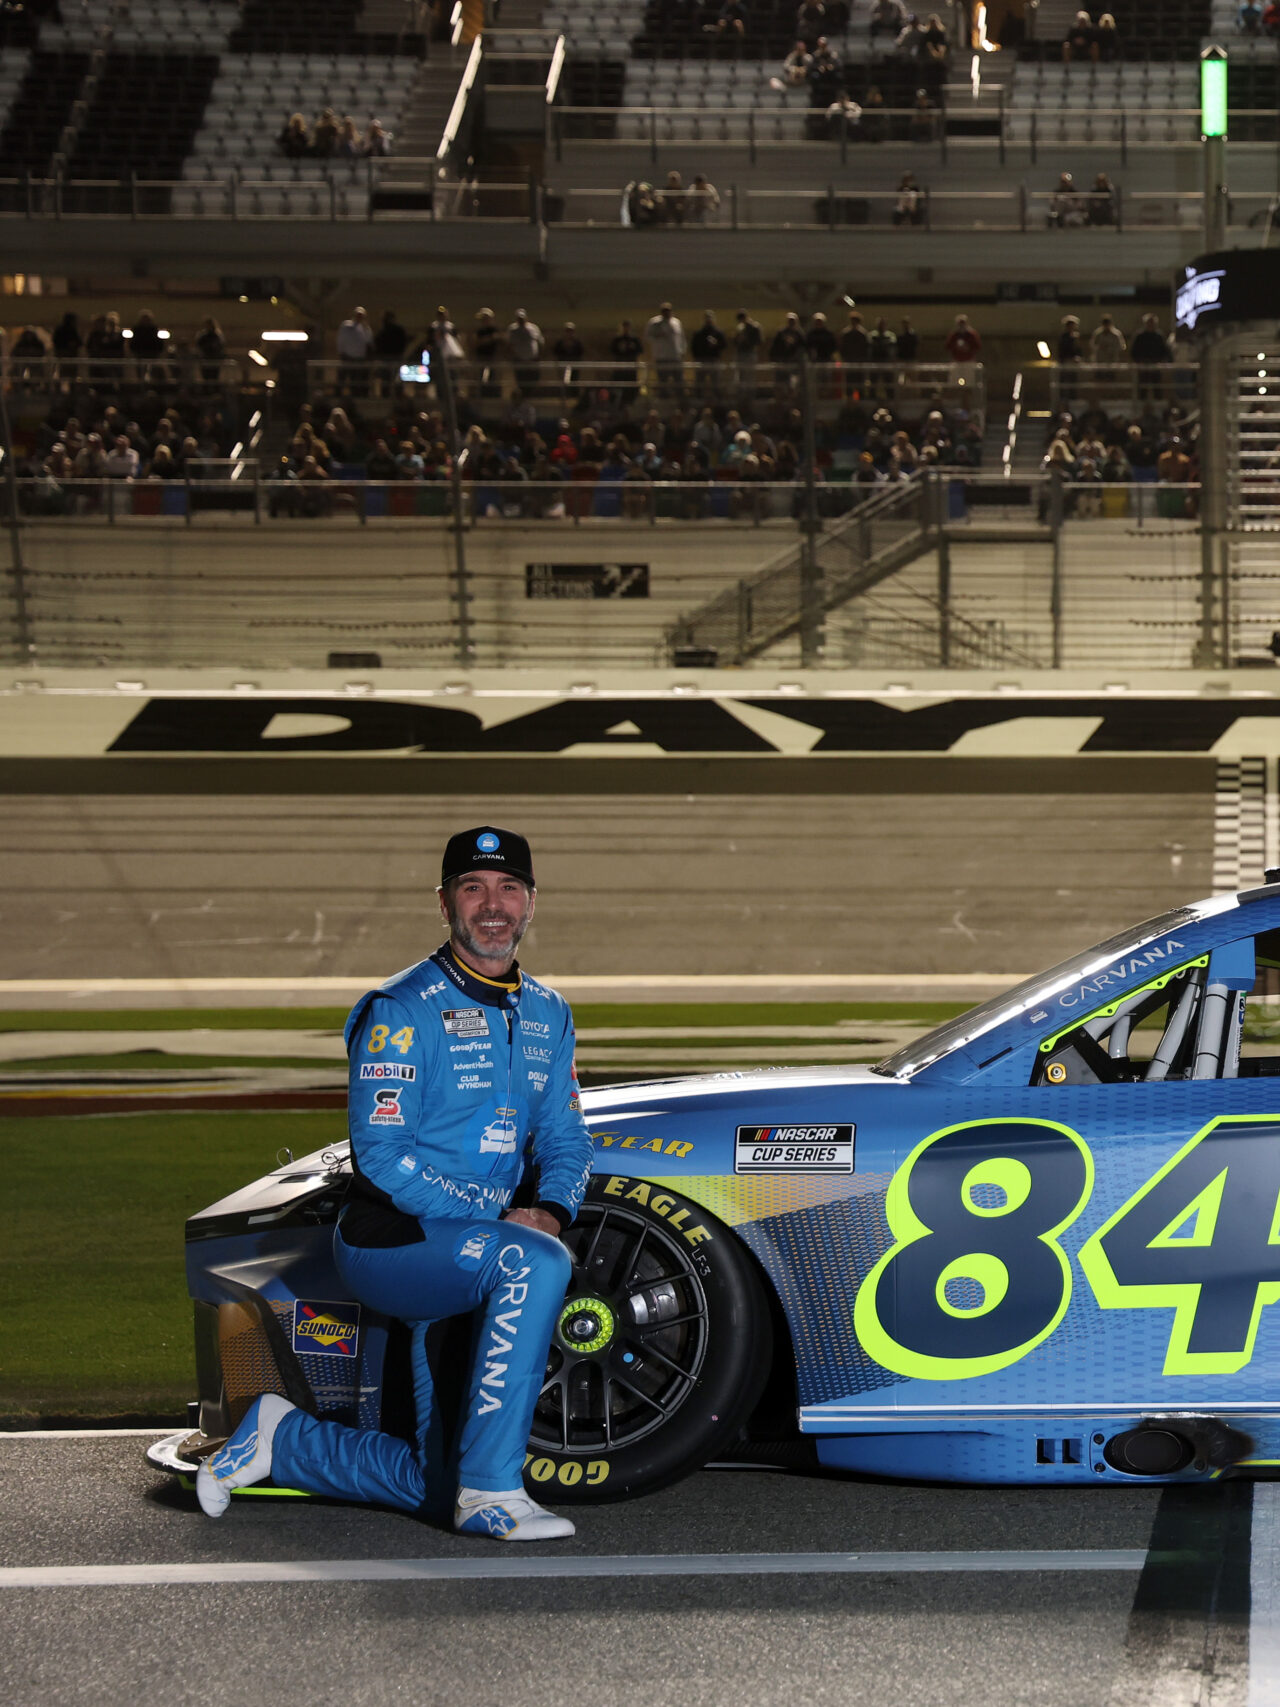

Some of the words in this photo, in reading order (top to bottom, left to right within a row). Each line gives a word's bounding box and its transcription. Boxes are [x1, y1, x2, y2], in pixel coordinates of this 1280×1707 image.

[472, 853, 505, 861] CARVANA
[1059, 939, 1185, 1007] CARVANA
[455, 1010, 479, 1018] NASCAR
[462, 1019, 482, 1028] SERIES
[520, 1020, 550, 1034] TOYOTA
[368, 1024, 415, 1054] 84
[449, 1041, 492, 1053] GOODYEAR
[362, 1064, 400, 1077] Mobil
[453, 1061, 494, 1071] AdventHealth
[460, 1074, 480, 1082] CLUB
[457, 1081, 492, 1090] WYNDHAM
[773, 1127, 838, 1142] NASCAR
[751, 1147, 784, 1162] CUP
[785, 1147, 838, 1162] SERIES
[602, 1175, 714, 1248] EAGLE
[298, 1321, 355, 1338] SUNOCO
